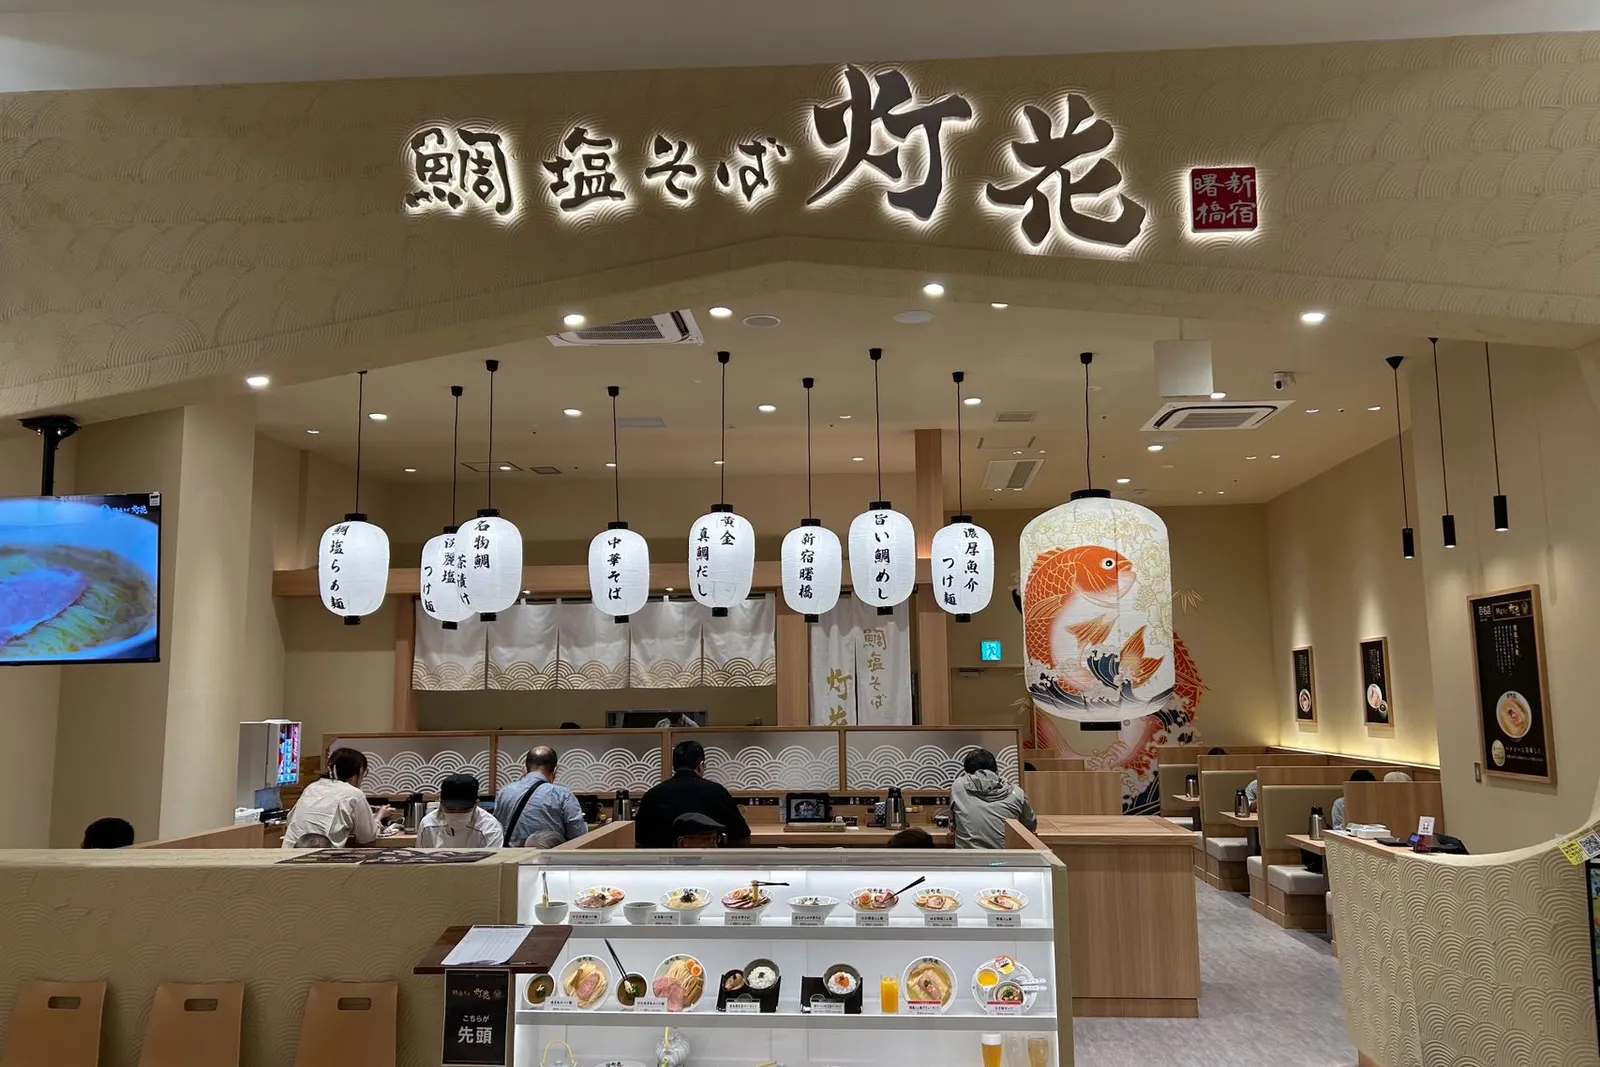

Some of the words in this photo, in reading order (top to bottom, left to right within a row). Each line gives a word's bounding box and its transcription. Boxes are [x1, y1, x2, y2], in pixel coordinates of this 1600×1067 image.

[406, 127, 787, 216] 鯛塩そば
[806, 64, 1147, 249] 灯花
[474, 520, 490, 569] 名物鯛
[720, 516, 735, 546] 黄金
[874, 513, 890, 600] 旨い鯛めし
[456, 553, 470, 605] 茶漬け
[607, 537, 622, 600] 中華そば
[696, 527, 710, 597] 真鯛だし
[799, 533, 816, 599] 新宿曙橋
[942, 557, 957, 606] つけ麺
[963, 528, 980, 592] 濃厚魚介
[423, 566, 436, 613] つけ麺
[863, 628, 887, 710] 鯛塩そば
[458, 1026, 493, 1045] 先頭
[462, 1015, 490, 1023] こちらが
